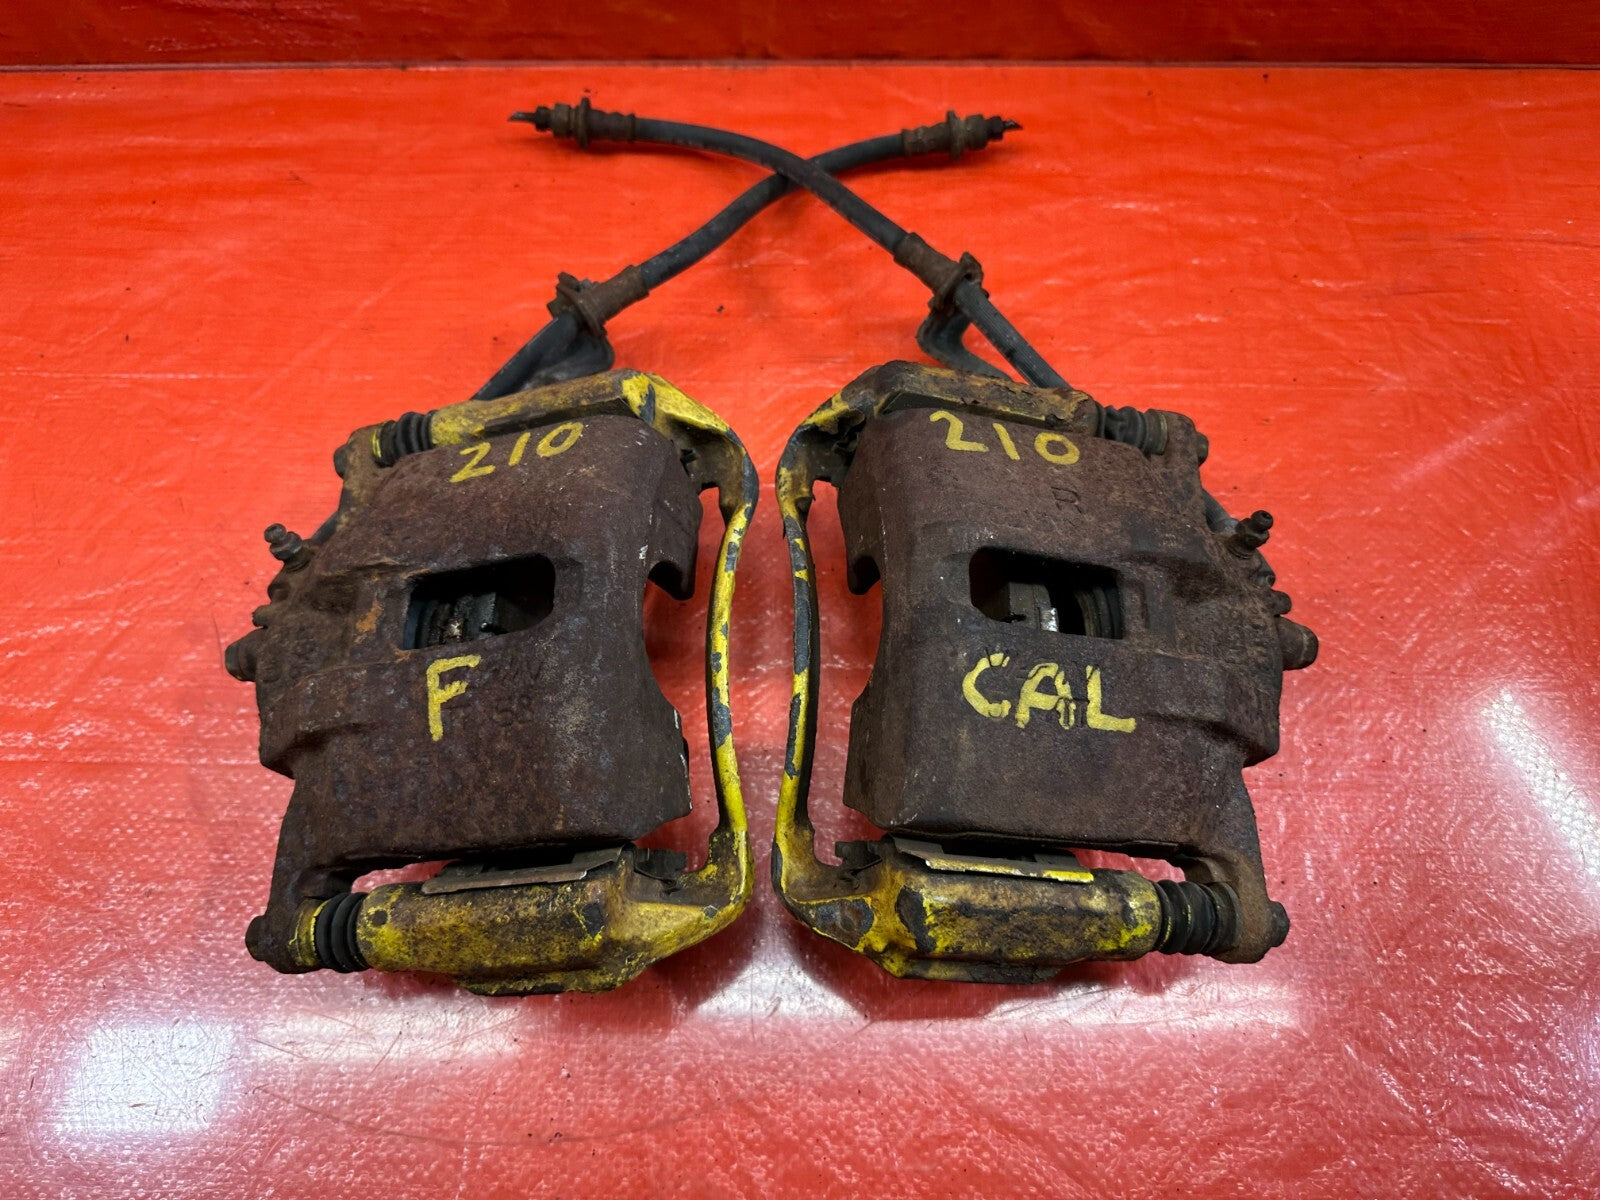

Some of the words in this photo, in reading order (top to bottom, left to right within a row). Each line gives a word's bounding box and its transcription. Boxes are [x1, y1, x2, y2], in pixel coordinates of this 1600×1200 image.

[451, 422, 583, 482] 210
[930, 411, 1080, 465] 210
[426, 655, 481, 741] F
[963, 653, 1136, 733] CAL
